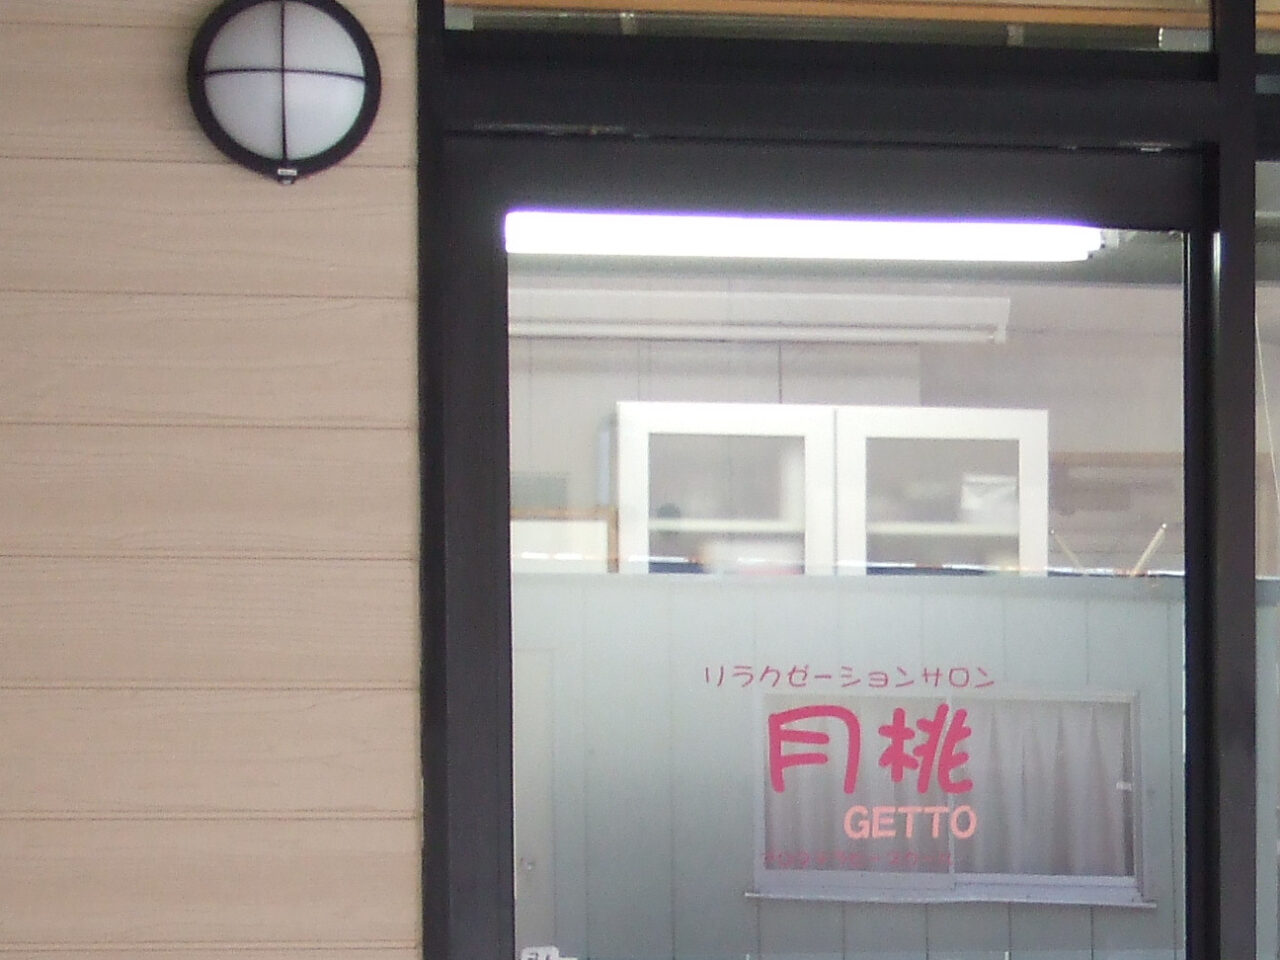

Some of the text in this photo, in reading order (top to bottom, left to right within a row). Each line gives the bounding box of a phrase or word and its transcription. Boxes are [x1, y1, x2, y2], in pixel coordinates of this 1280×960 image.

[705, 664, 995, 688] リラクゼーションサロン
[768, 703, 974, 794] 月桃
[843, 804, 977, 839] GETTO
